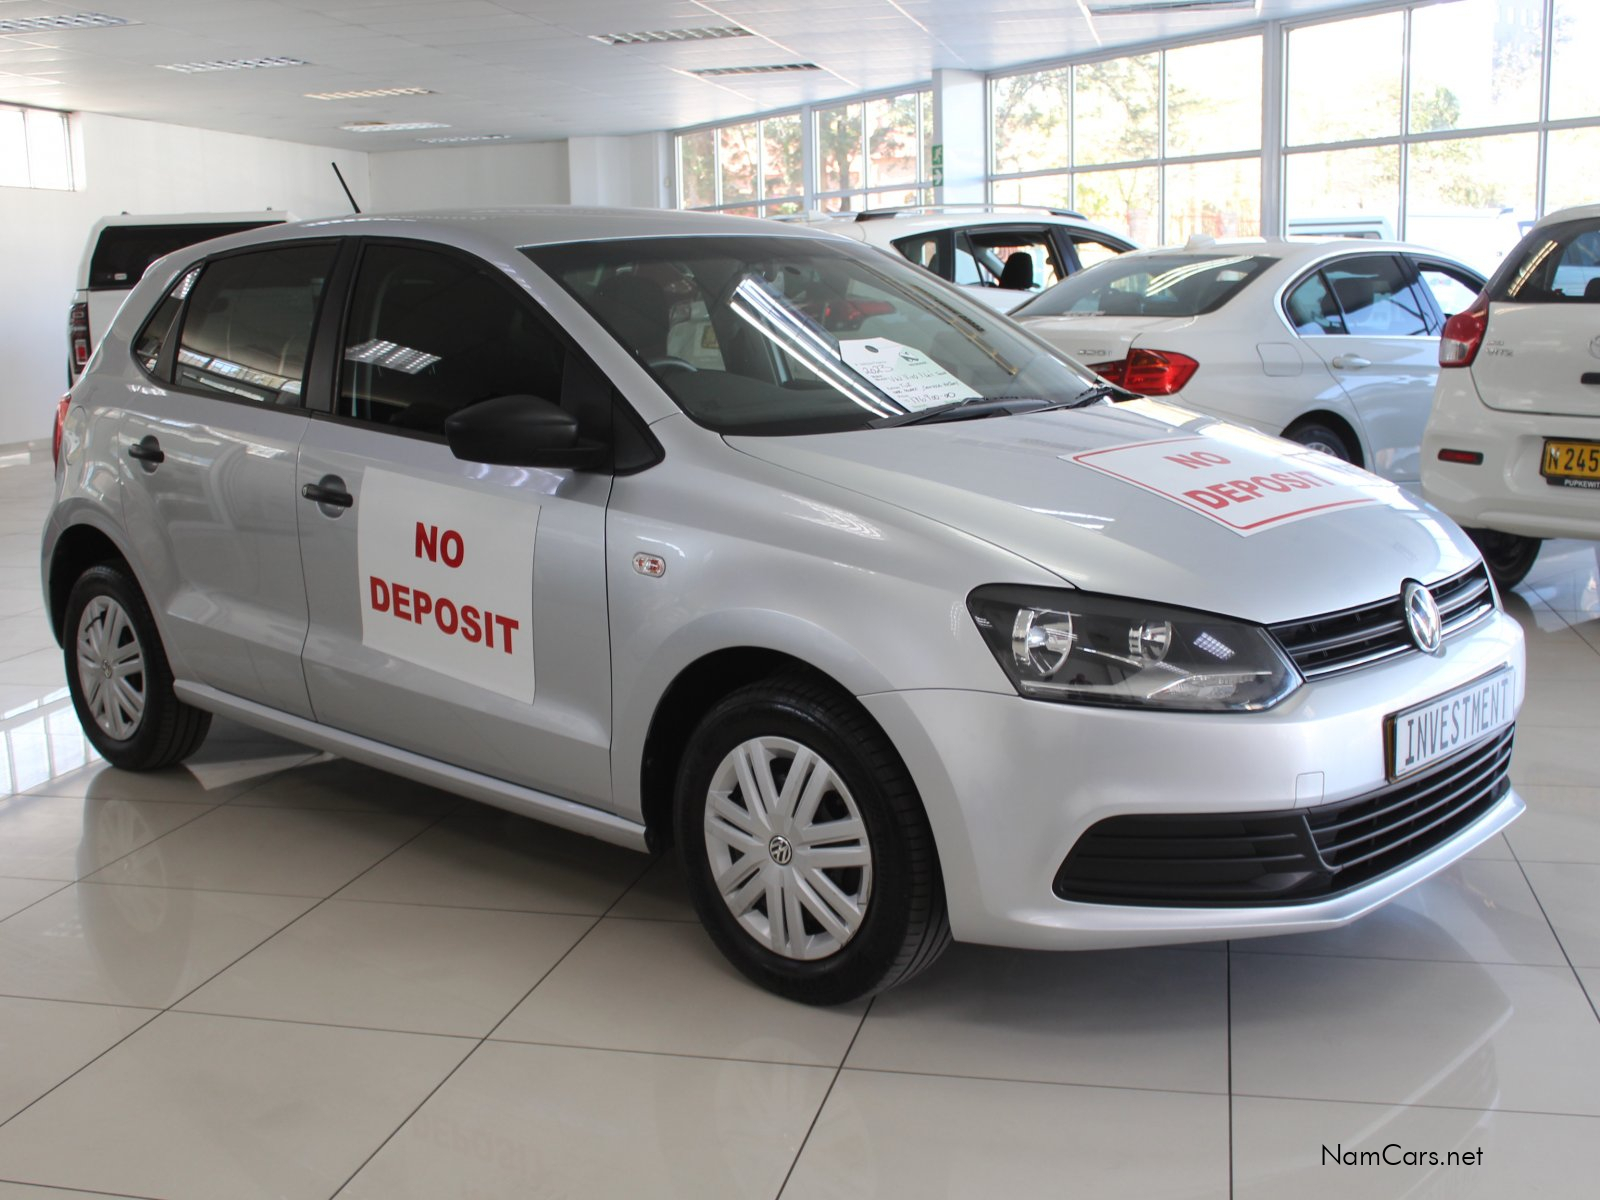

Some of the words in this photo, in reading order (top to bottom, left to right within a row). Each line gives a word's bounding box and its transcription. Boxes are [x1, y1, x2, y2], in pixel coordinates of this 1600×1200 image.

[1163, 451, 1231, 470] NO
[1547, 447, 1560, 470] N
[1564, 447, 1600, 472] 245
[1182, 471, 1336, 510] DEPOSIT
[415, 521, 465, 568] NO
[369, 575, 519, 655] DEPOSIT
[1405, 678, 1509, 766] INVESTMENT
